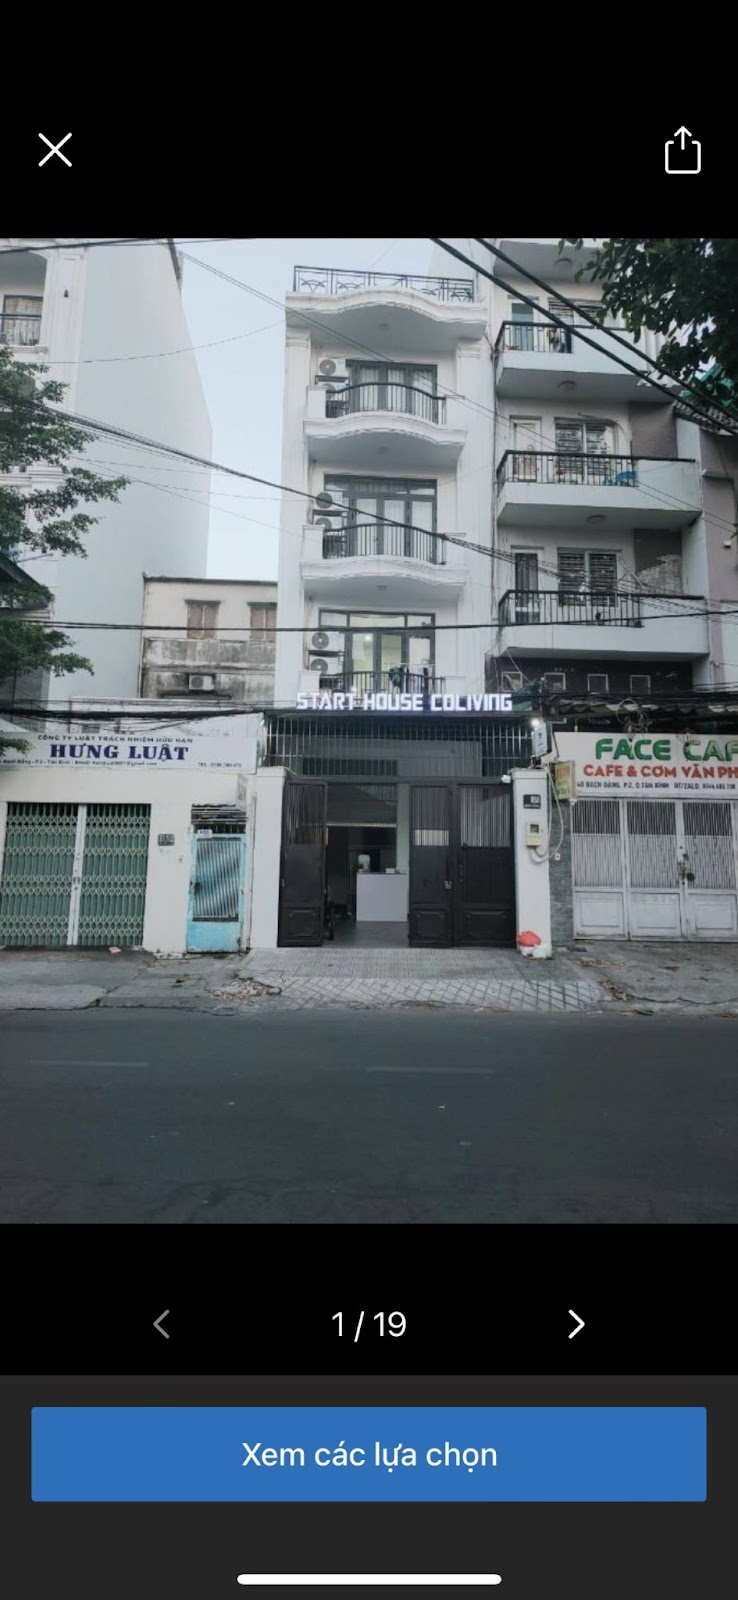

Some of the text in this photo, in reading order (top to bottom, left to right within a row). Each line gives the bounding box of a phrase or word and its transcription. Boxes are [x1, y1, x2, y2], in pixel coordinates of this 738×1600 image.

[296, 692, 513, 711] START HOUSE COLIVING
[49, 743, 189, 761] HƯNG LUẬT
[595, 738, 671, 760] FACE
[583, 764, 623, 777] CAFE
[626, 764, 638, 778] &
[640, 764, 677, 778] CƠM
[680, 763, 716, 779] VĂN
